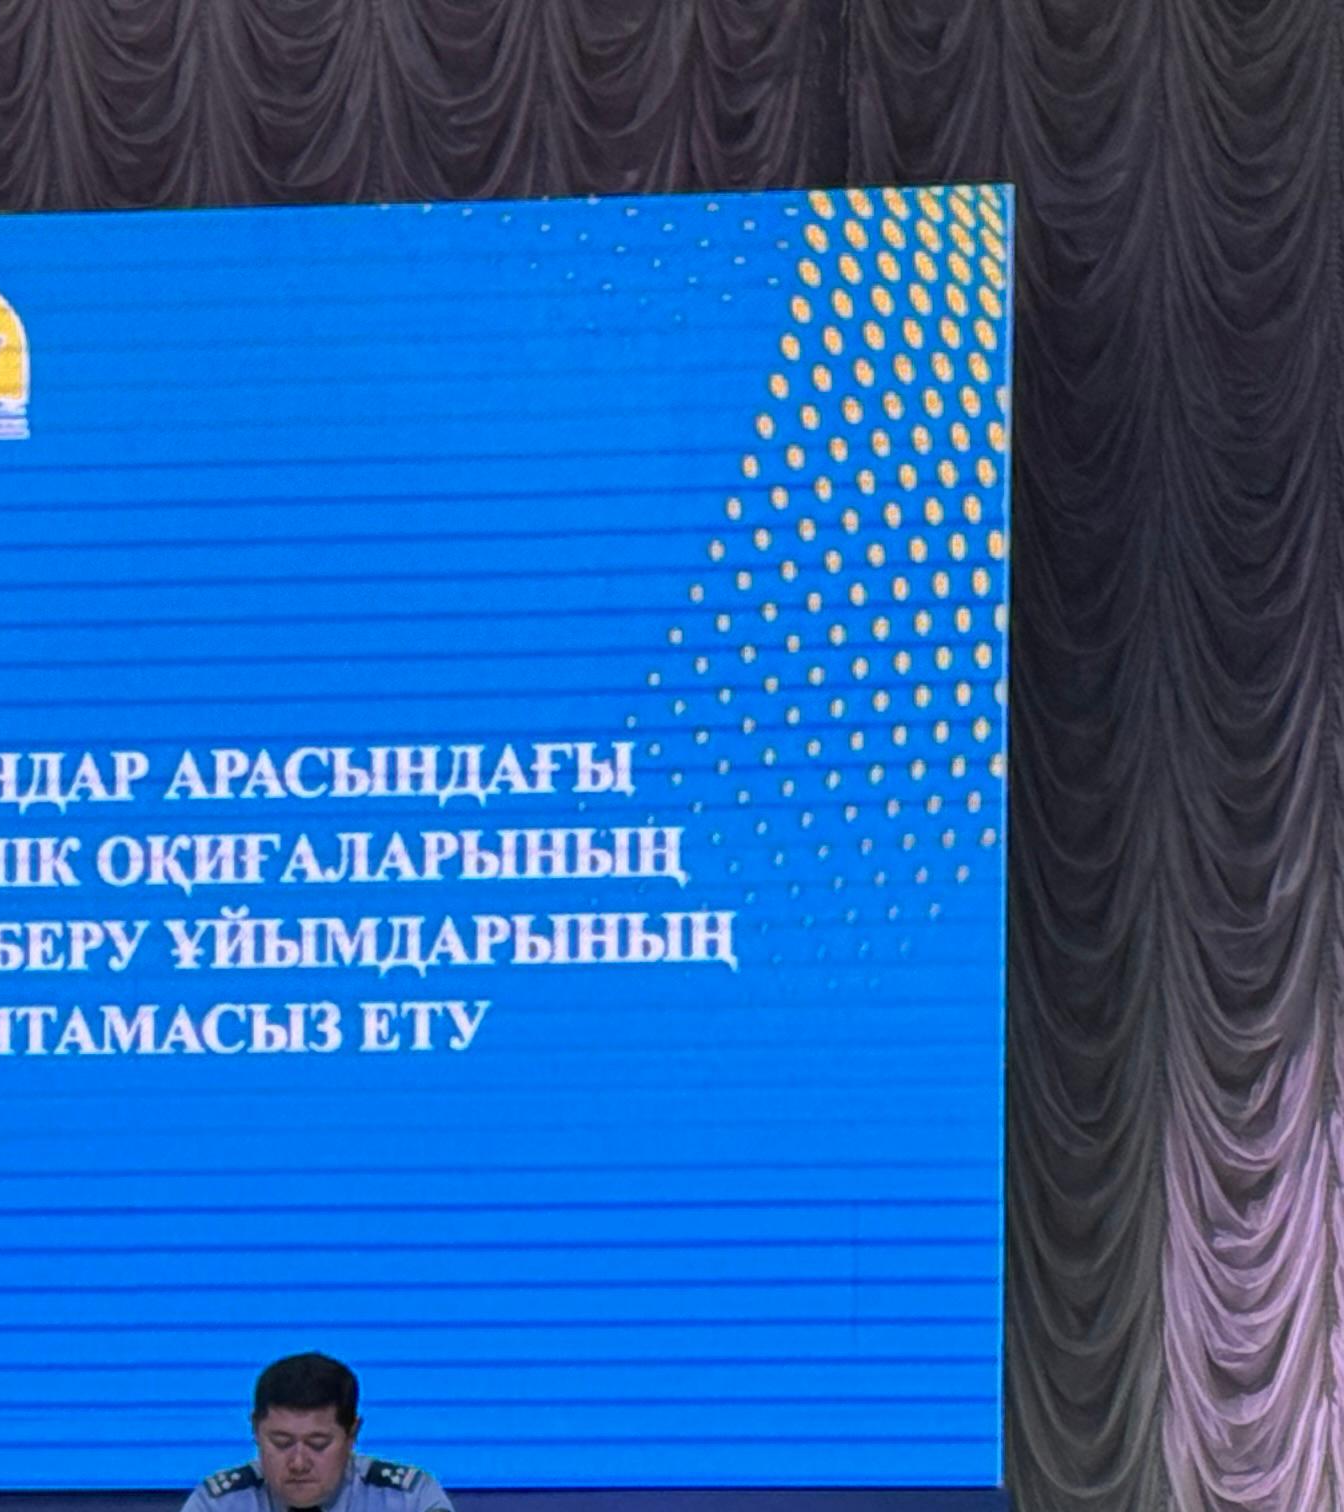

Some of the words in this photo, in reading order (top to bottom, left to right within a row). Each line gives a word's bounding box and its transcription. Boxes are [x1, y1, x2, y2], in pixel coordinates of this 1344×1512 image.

[165, 742, 636, 808] АРАСЫНДАҒЫ
[97, 826, 691, 897] ОҚИҒАЛАРЫНЫҢ
[164, 906, 740, 978] ҰЙЫМДАРЫНЫҢ
[359, 1000, 493, 1053] ЕТУ
